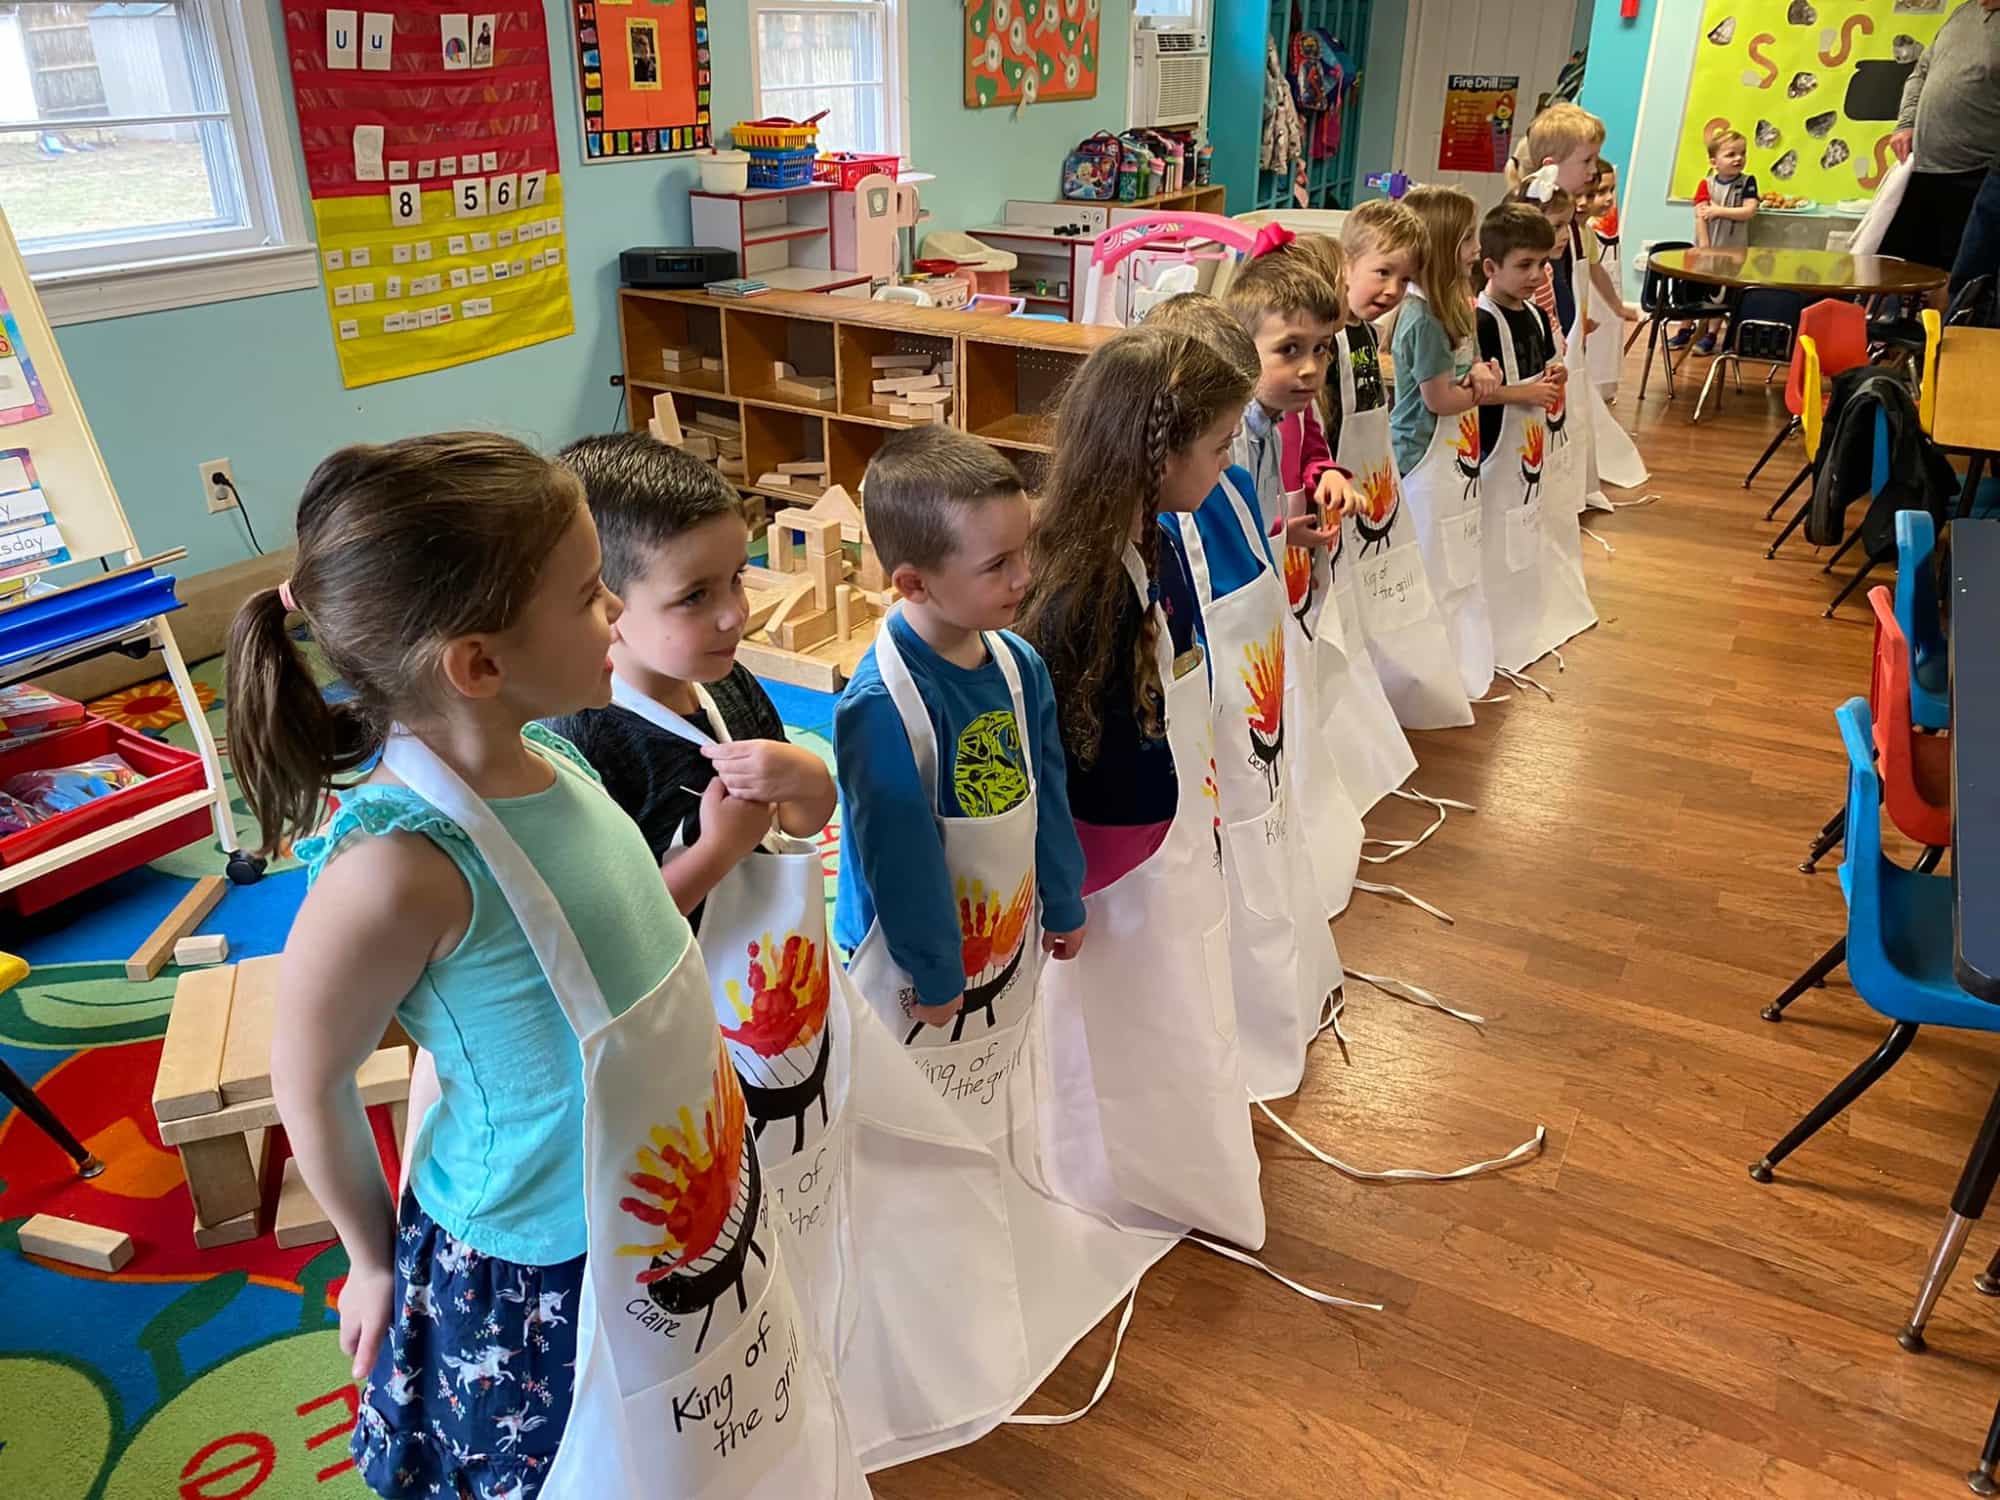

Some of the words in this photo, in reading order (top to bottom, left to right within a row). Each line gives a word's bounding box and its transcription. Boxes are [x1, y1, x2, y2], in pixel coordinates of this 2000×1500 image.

[335, 29, 347, 49] U
[371, 34, 383, 49] u
[1452, 76, 1474, 89] Fire
[1475, 76, 1498, 89] Drill
[399, 191, 413, 217] 8
[464, 185, 478, 210] 5
[498, 181, 510, 205] 6
[526, 177, 539, 200] 7
[951, 1076, 984, 1101] the
[980, 1047, 1021, 1105] grill
[969, 1041, 998, 1073] of
[798, 1147, 827, 1193] of
[625, 1298, 682, 1339] Claire
[671, 1373, 734, 1433] King
[744, 1310, 771, 1368] of
[712, 1407, 764, 1457] the
[773, 1317, 799, 1423] grill
